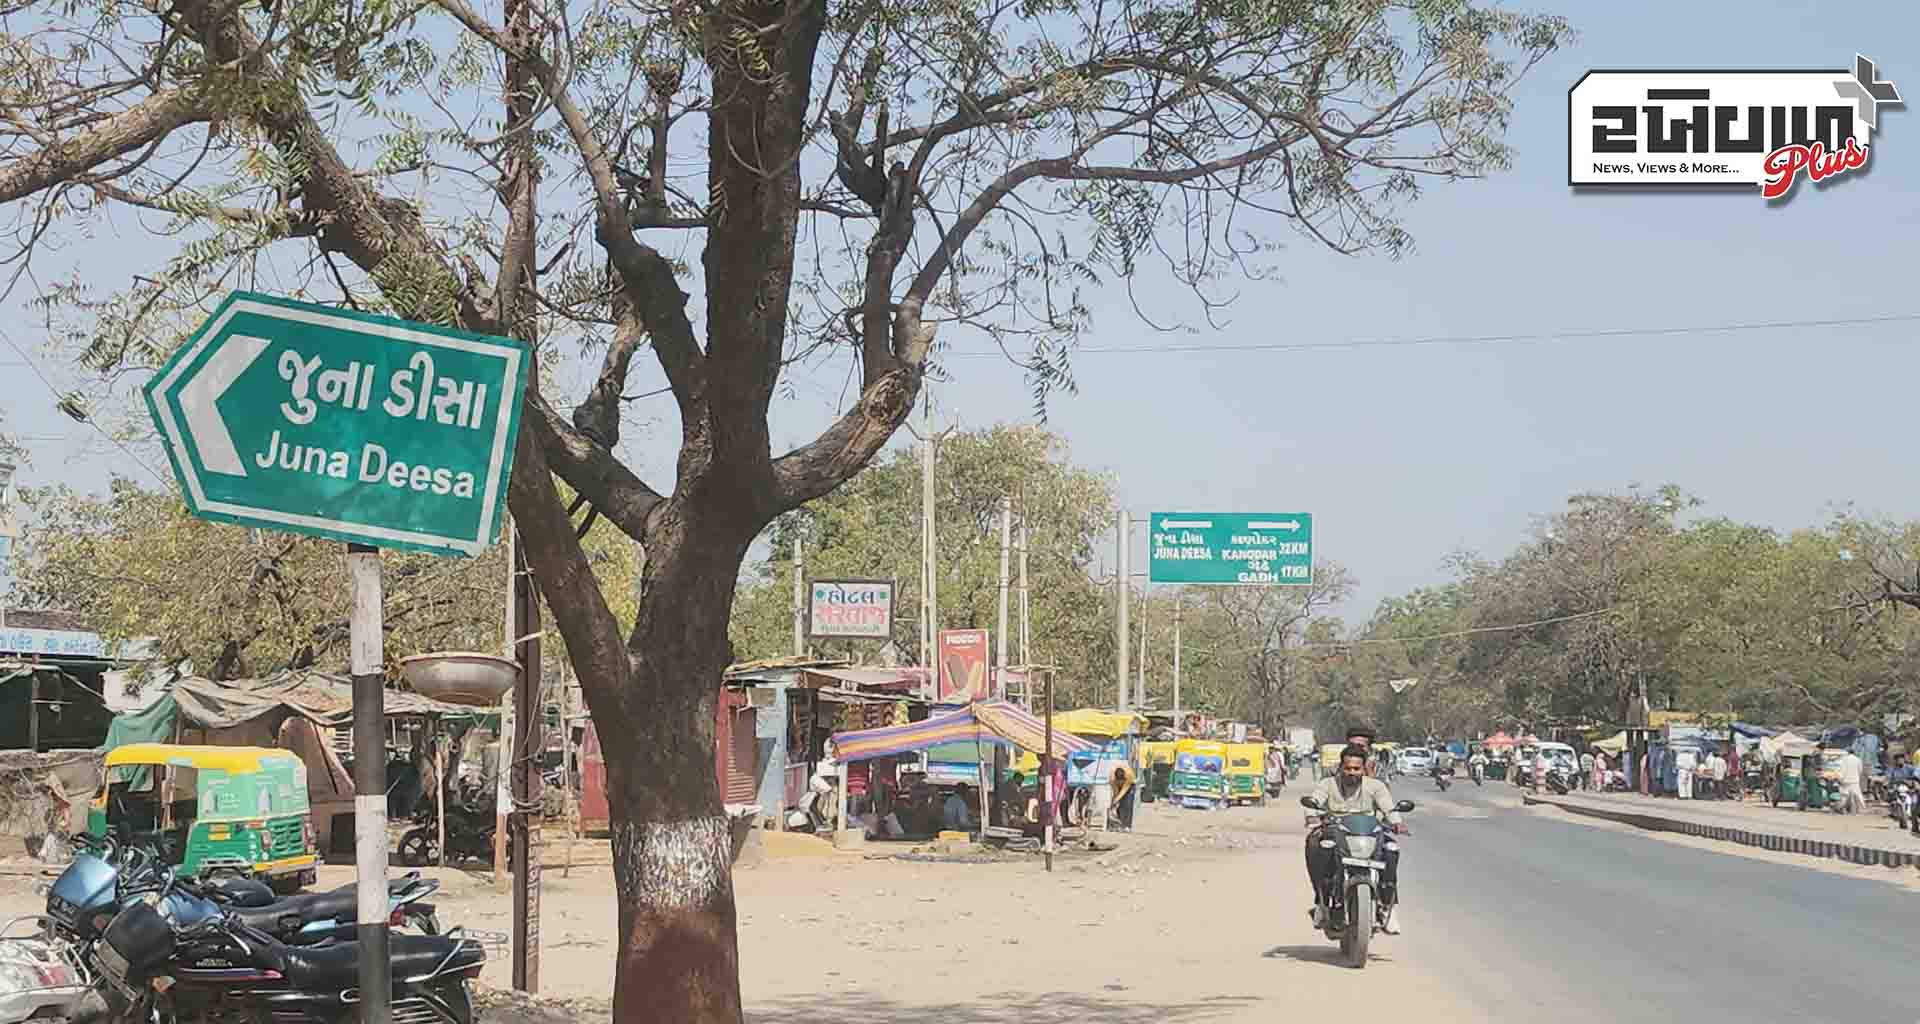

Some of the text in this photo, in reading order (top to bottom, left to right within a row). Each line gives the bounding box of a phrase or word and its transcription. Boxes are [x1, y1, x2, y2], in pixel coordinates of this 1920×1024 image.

[277, 349, 488, 430] જુના ડીસા
[255, 430, 475, 499] Juna Deesa
[1237, 572, 1280, 583] GADH
